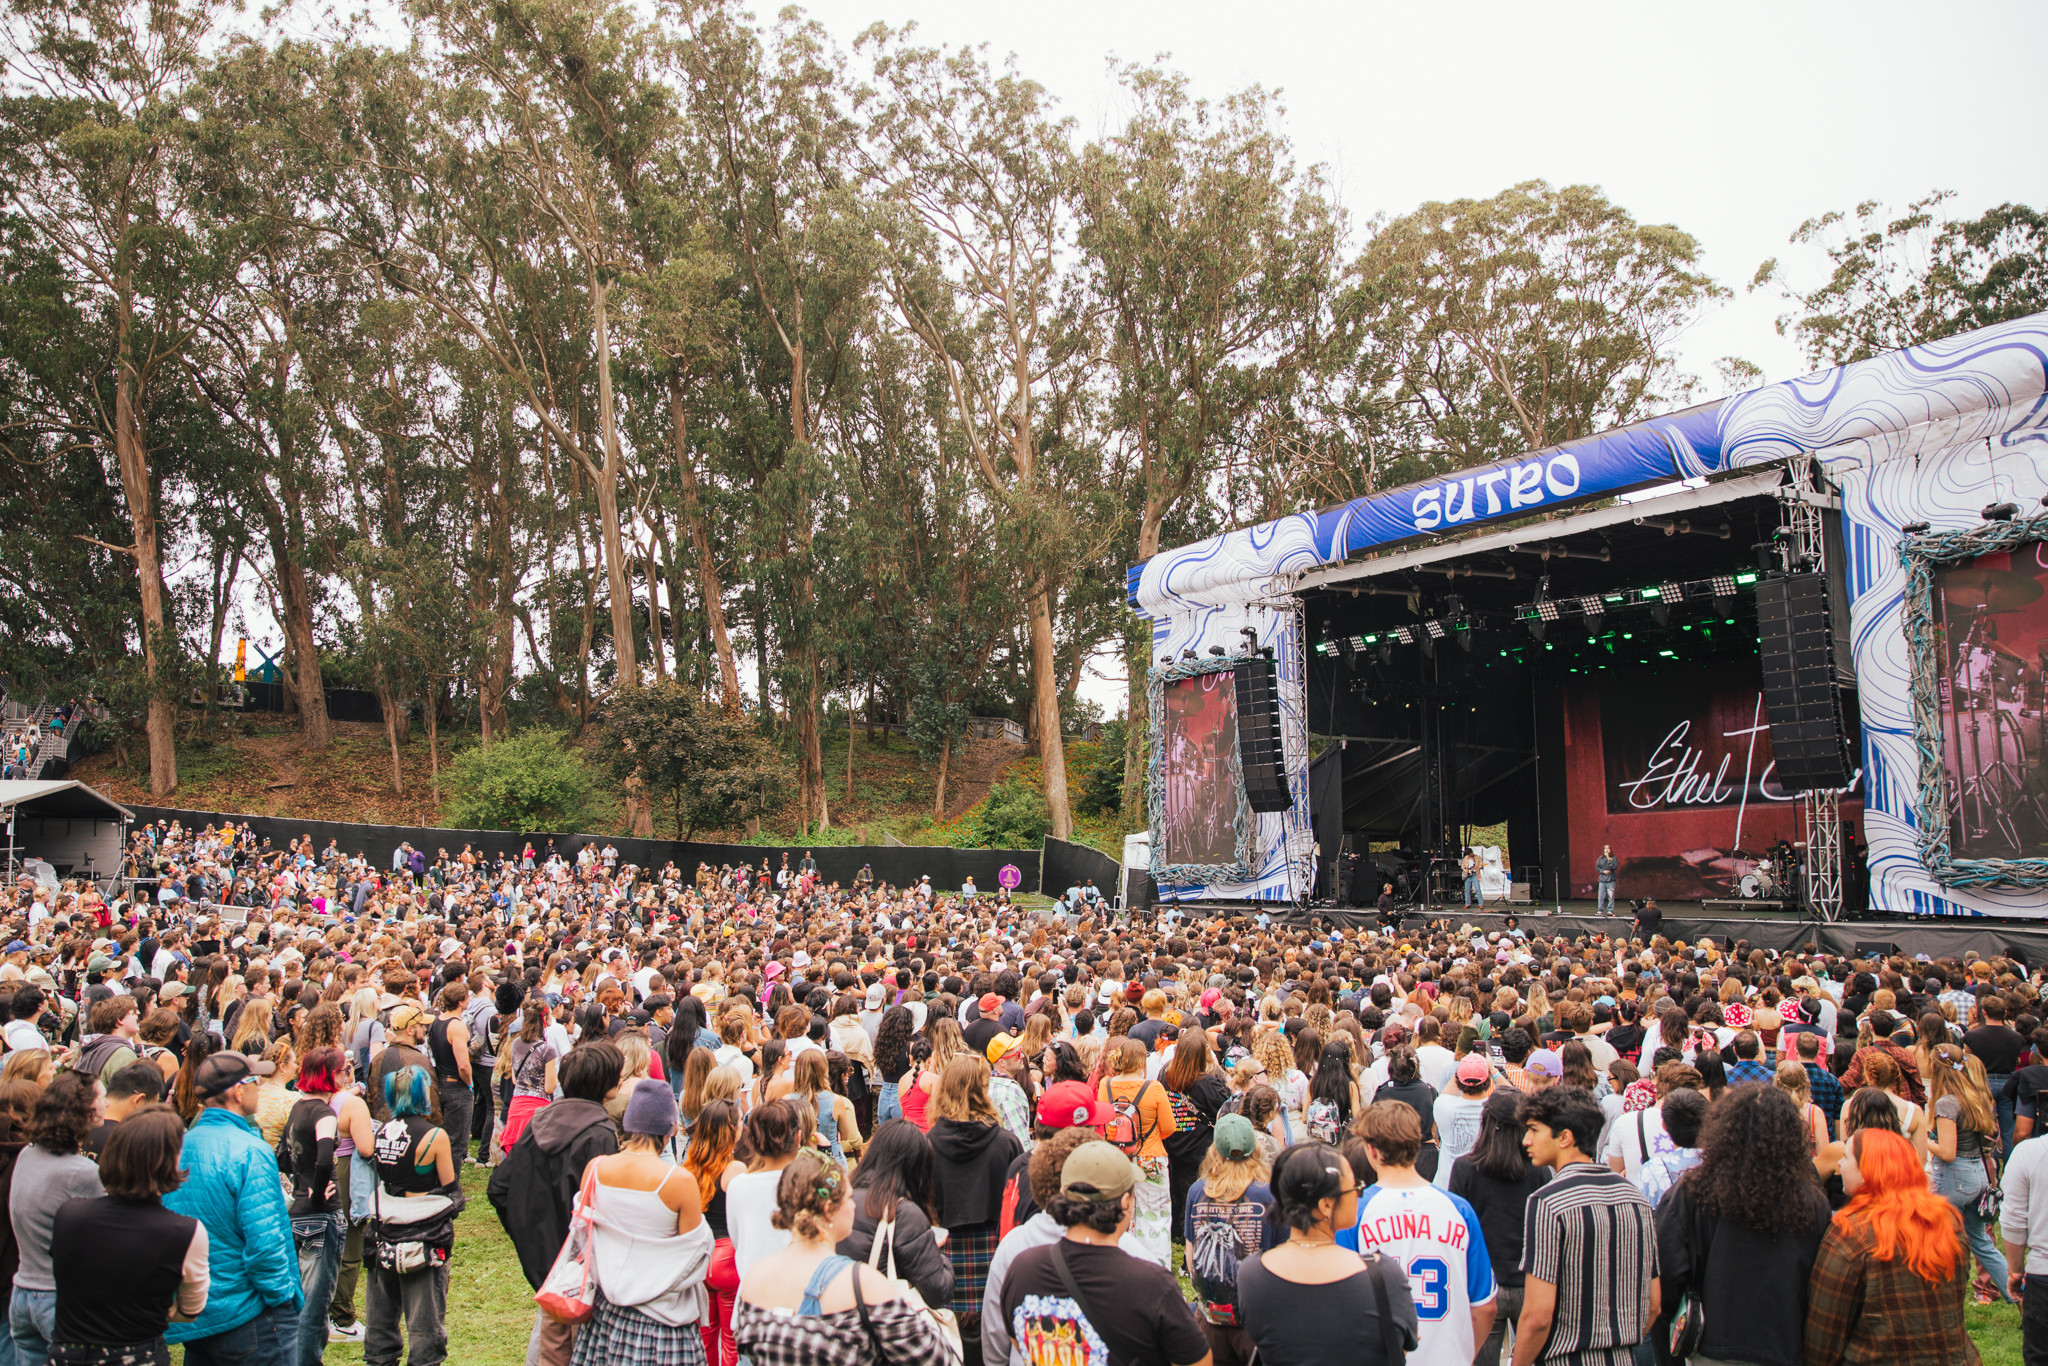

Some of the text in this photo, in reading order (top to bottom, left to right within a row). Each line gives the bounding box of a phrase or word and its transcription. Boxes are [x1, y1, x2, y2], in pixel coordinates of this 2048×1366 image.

[1412, 453, 1580, 530] SUTRO
[1619, 719, 1733, 809] Ethel
[1361, 1209, 1466, 1252] ACUÑA JR.
